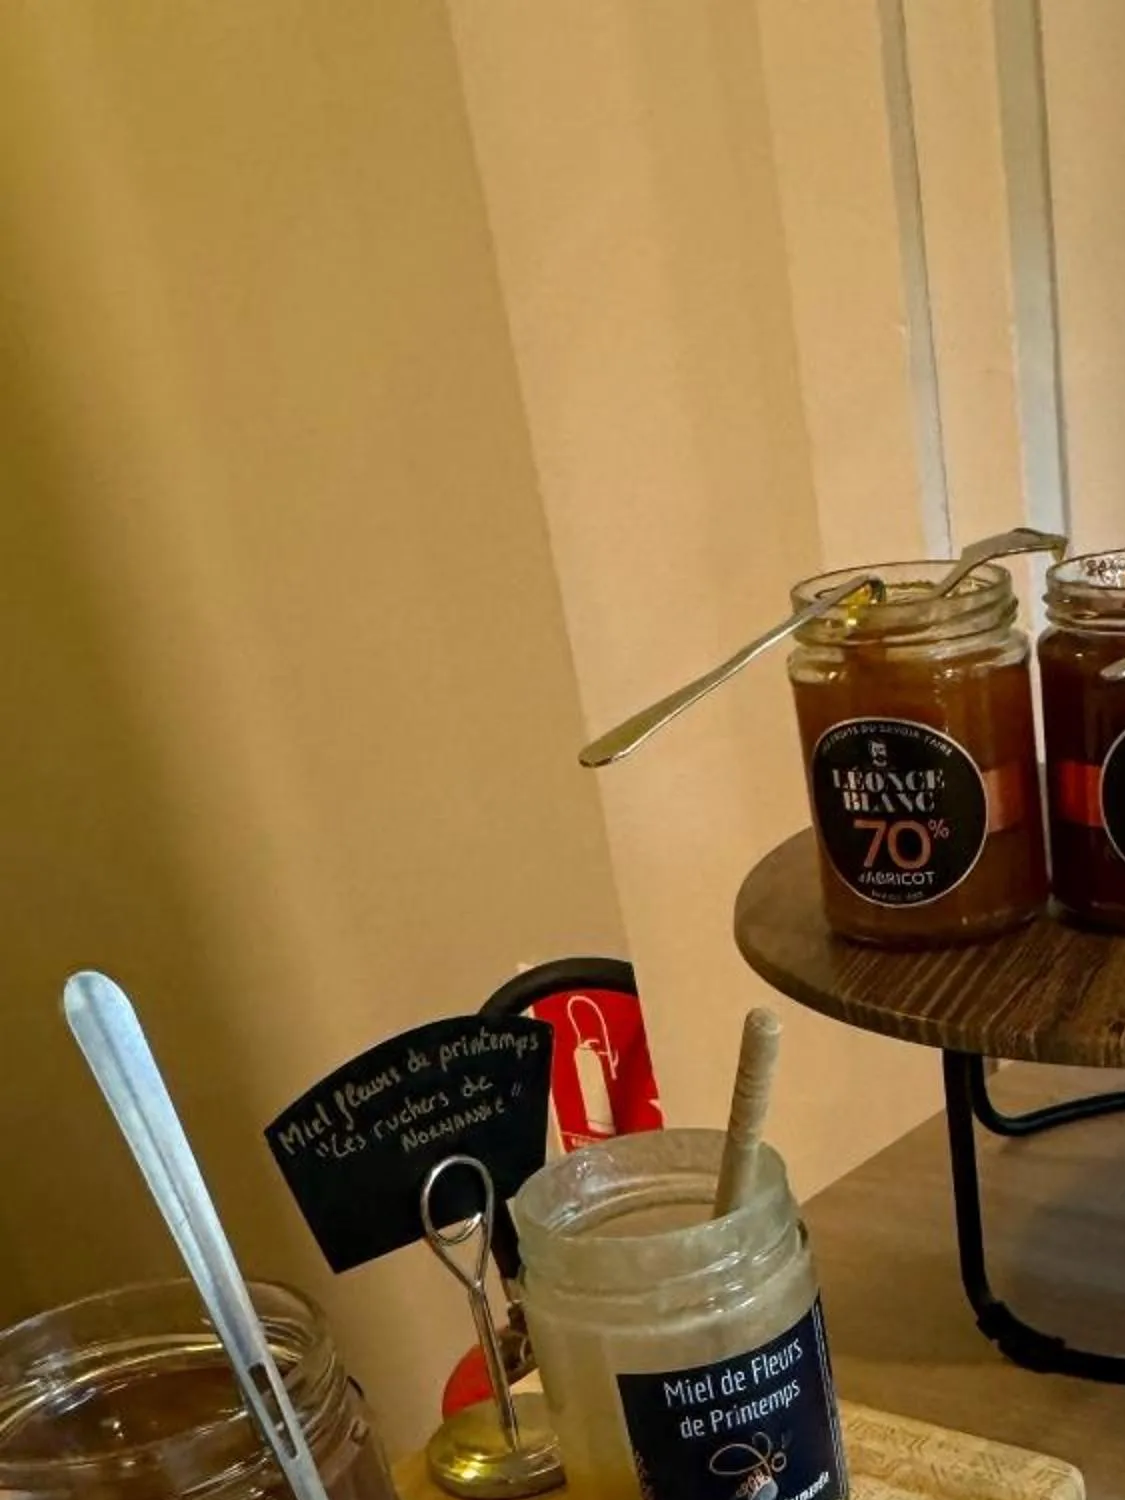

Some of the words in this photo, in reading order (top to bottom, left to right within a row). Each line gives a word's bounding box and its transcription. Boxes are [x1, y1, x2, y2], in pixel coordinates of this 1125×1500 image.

[843, 791, 935, 813] BLANC
[277, 1102, 333, 1155] Miel
[333, 1066, 401, 1131] fleurs
[407, 1048, 431, 1073] de
[438, 1026, 540, 1072] printemps
[373, 1090, 449, 1140] ruchers
[461, 1075, 494, 1098] de
[663, 1373, 715, 1408] Miel
[720, 1368, 747, 1396] de
[751, 1337, 803, 1386] Fleurs
[679, 1416, 705, 1439] de
[710, 1378, 801, 1433] Printemps
